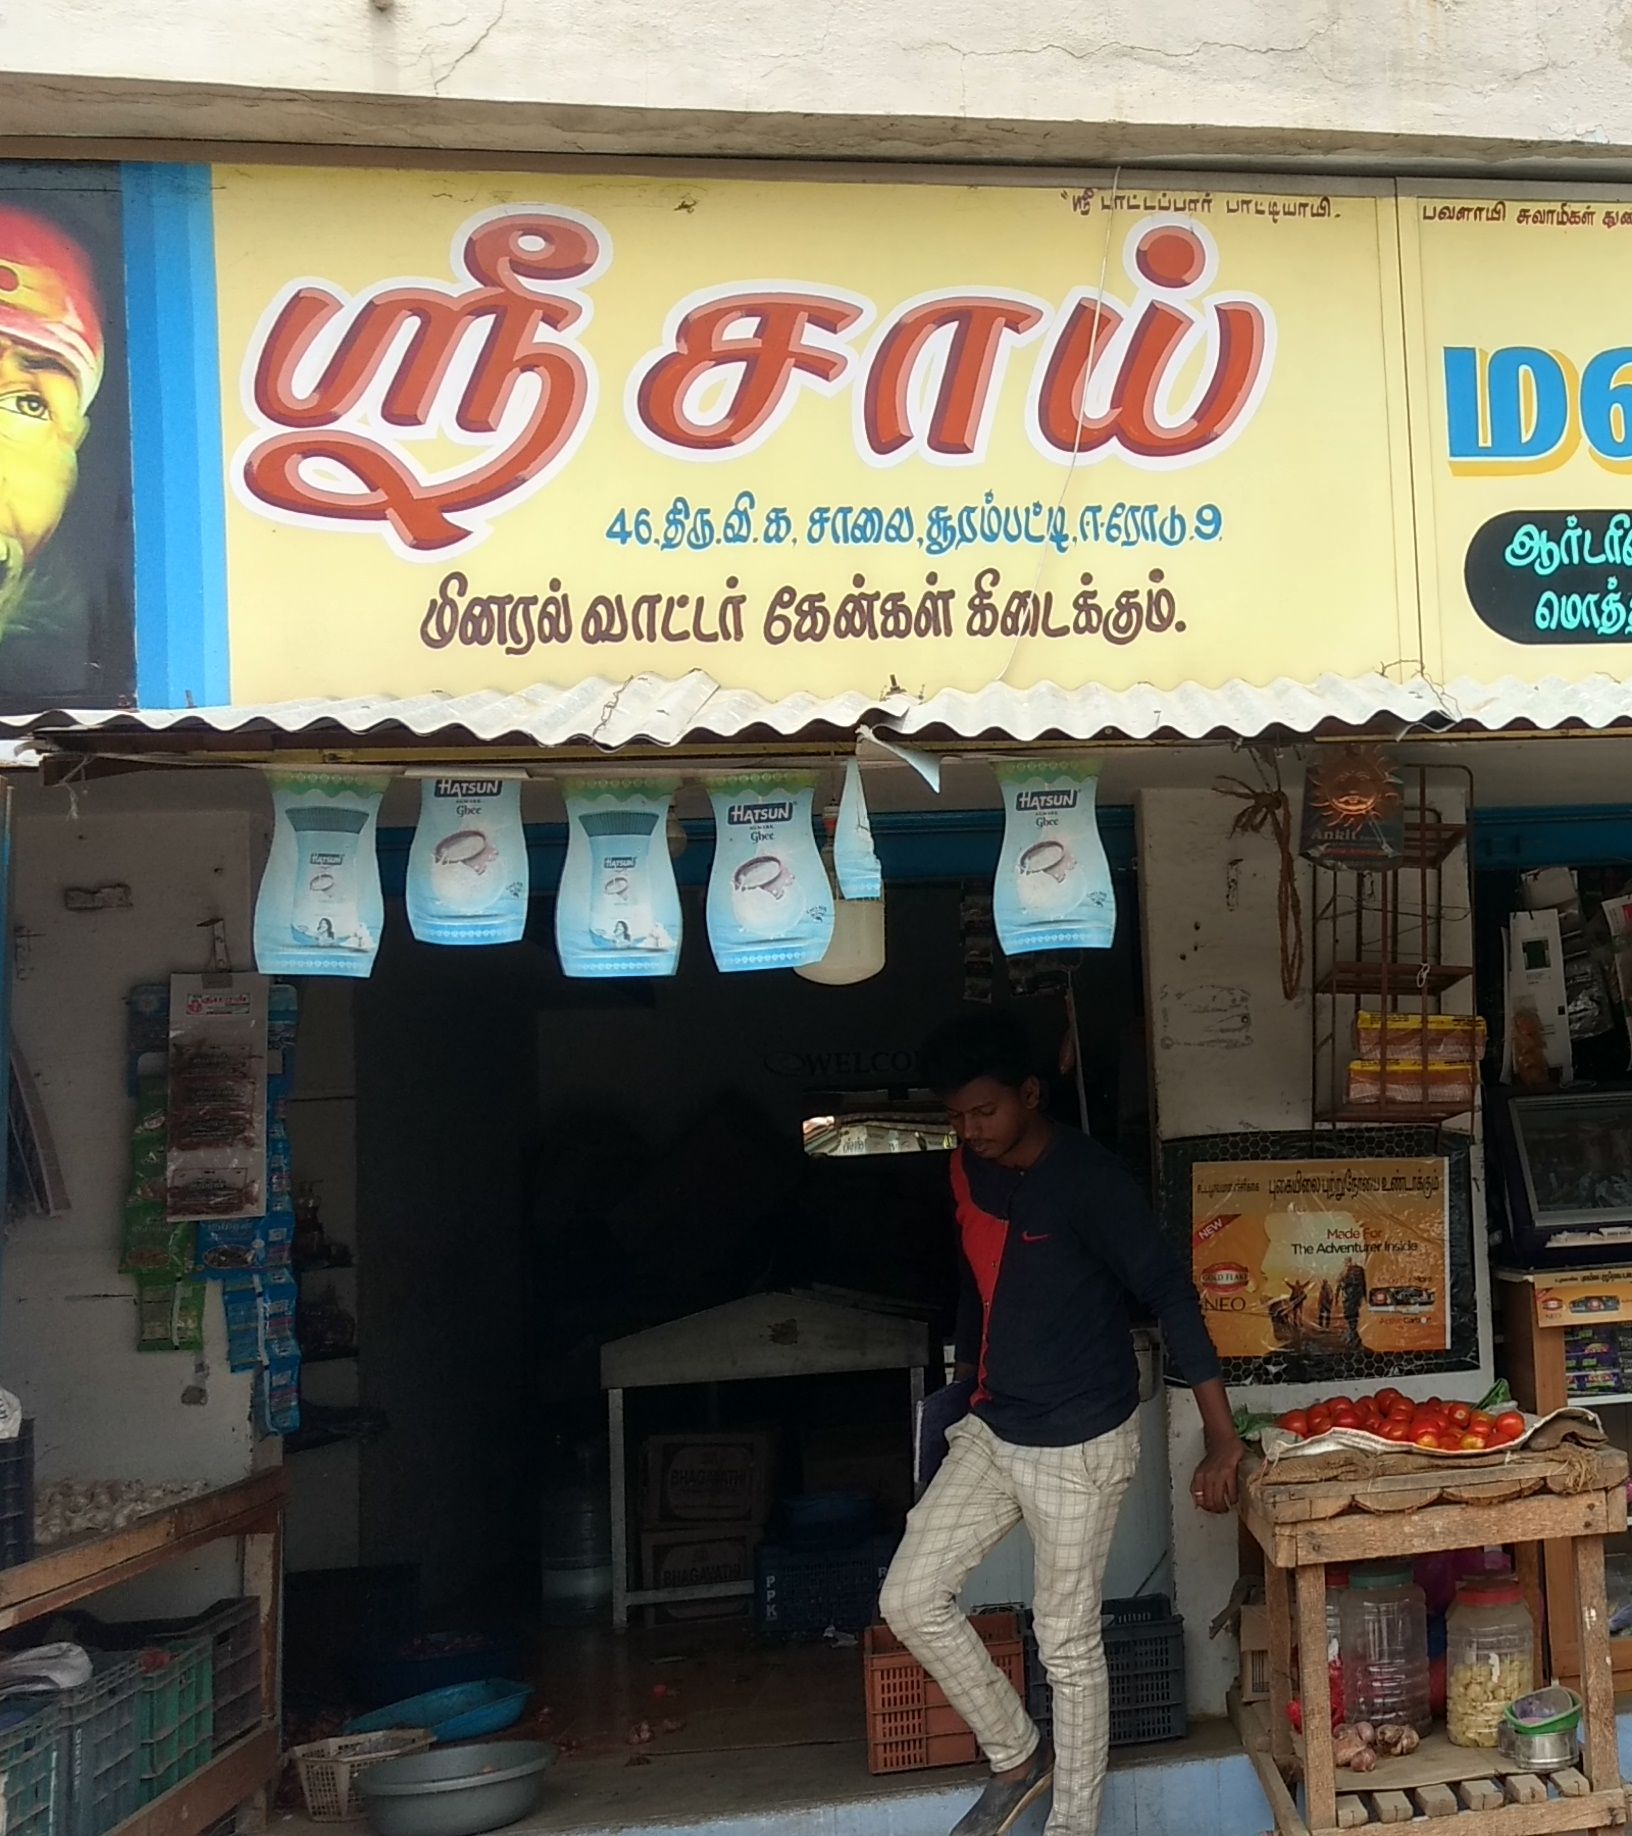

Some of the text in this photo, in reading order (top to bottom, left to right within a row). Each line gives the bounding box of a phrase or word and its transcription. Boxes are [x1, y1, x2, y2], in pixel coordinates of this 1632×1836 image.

[242, 213, 1263, 549] ஸ்ரீ சாய்
[420, 570, 572, 656] மினரல்
[580, 576, 747, 645] வாட்டர்
[764, 573, 956, 645] கேன்கள்
[437, 780, 499, 799] HATSUN
[1018, 789, 1074, 810] HATSUN
[456, 804, 482, 818] Ghee
[731, 802, 790, 824] HATSUN
[1036, 817, 1059, 828] Ghee
[751, 831, 774, 844] Ghee
[1198, 1218, 1223, 1239] NEW
[1327, 1227, 1382, 1240] Made For
[1291, 1240, 1418, 1255] The Adventurer Inside
[1203, 1296, 1246, 1312] NEO
